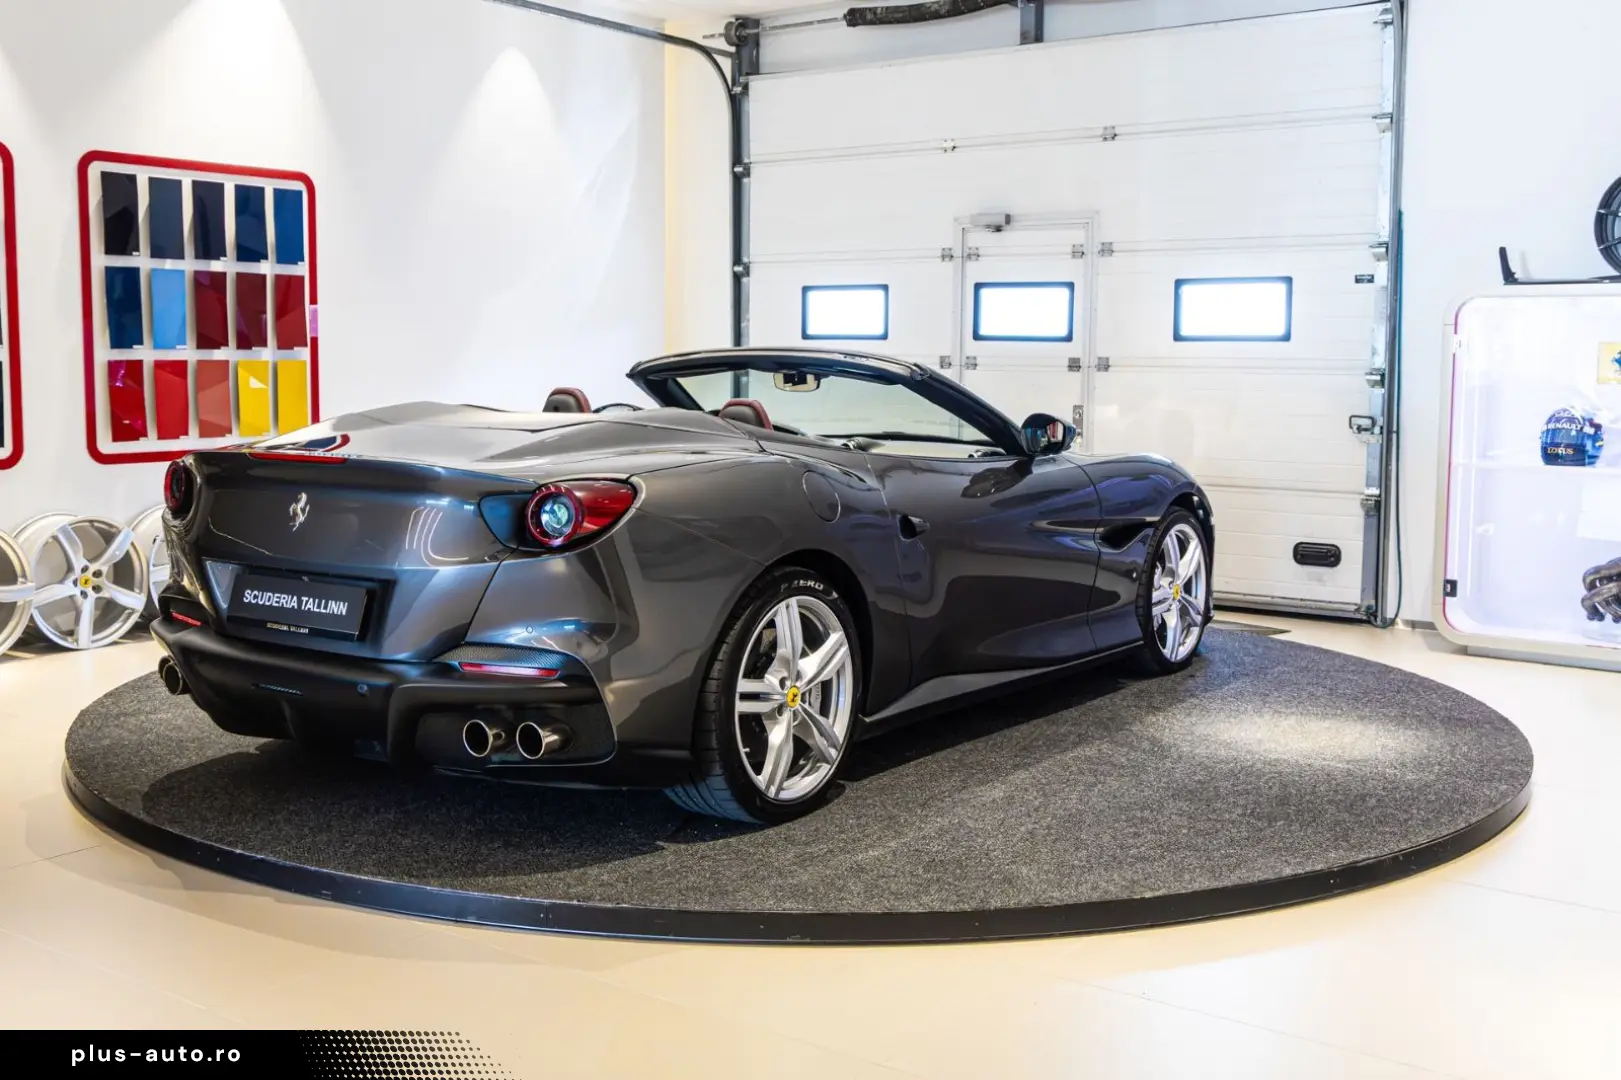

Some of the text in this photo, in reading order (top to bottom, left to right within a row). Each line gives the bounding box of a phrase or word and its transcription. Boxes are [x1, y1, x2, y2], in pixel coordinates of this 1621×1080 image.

[791, 579, 824, 591] ZERO
[243, 589, 348, 616] SCUDERIA TALLINN
